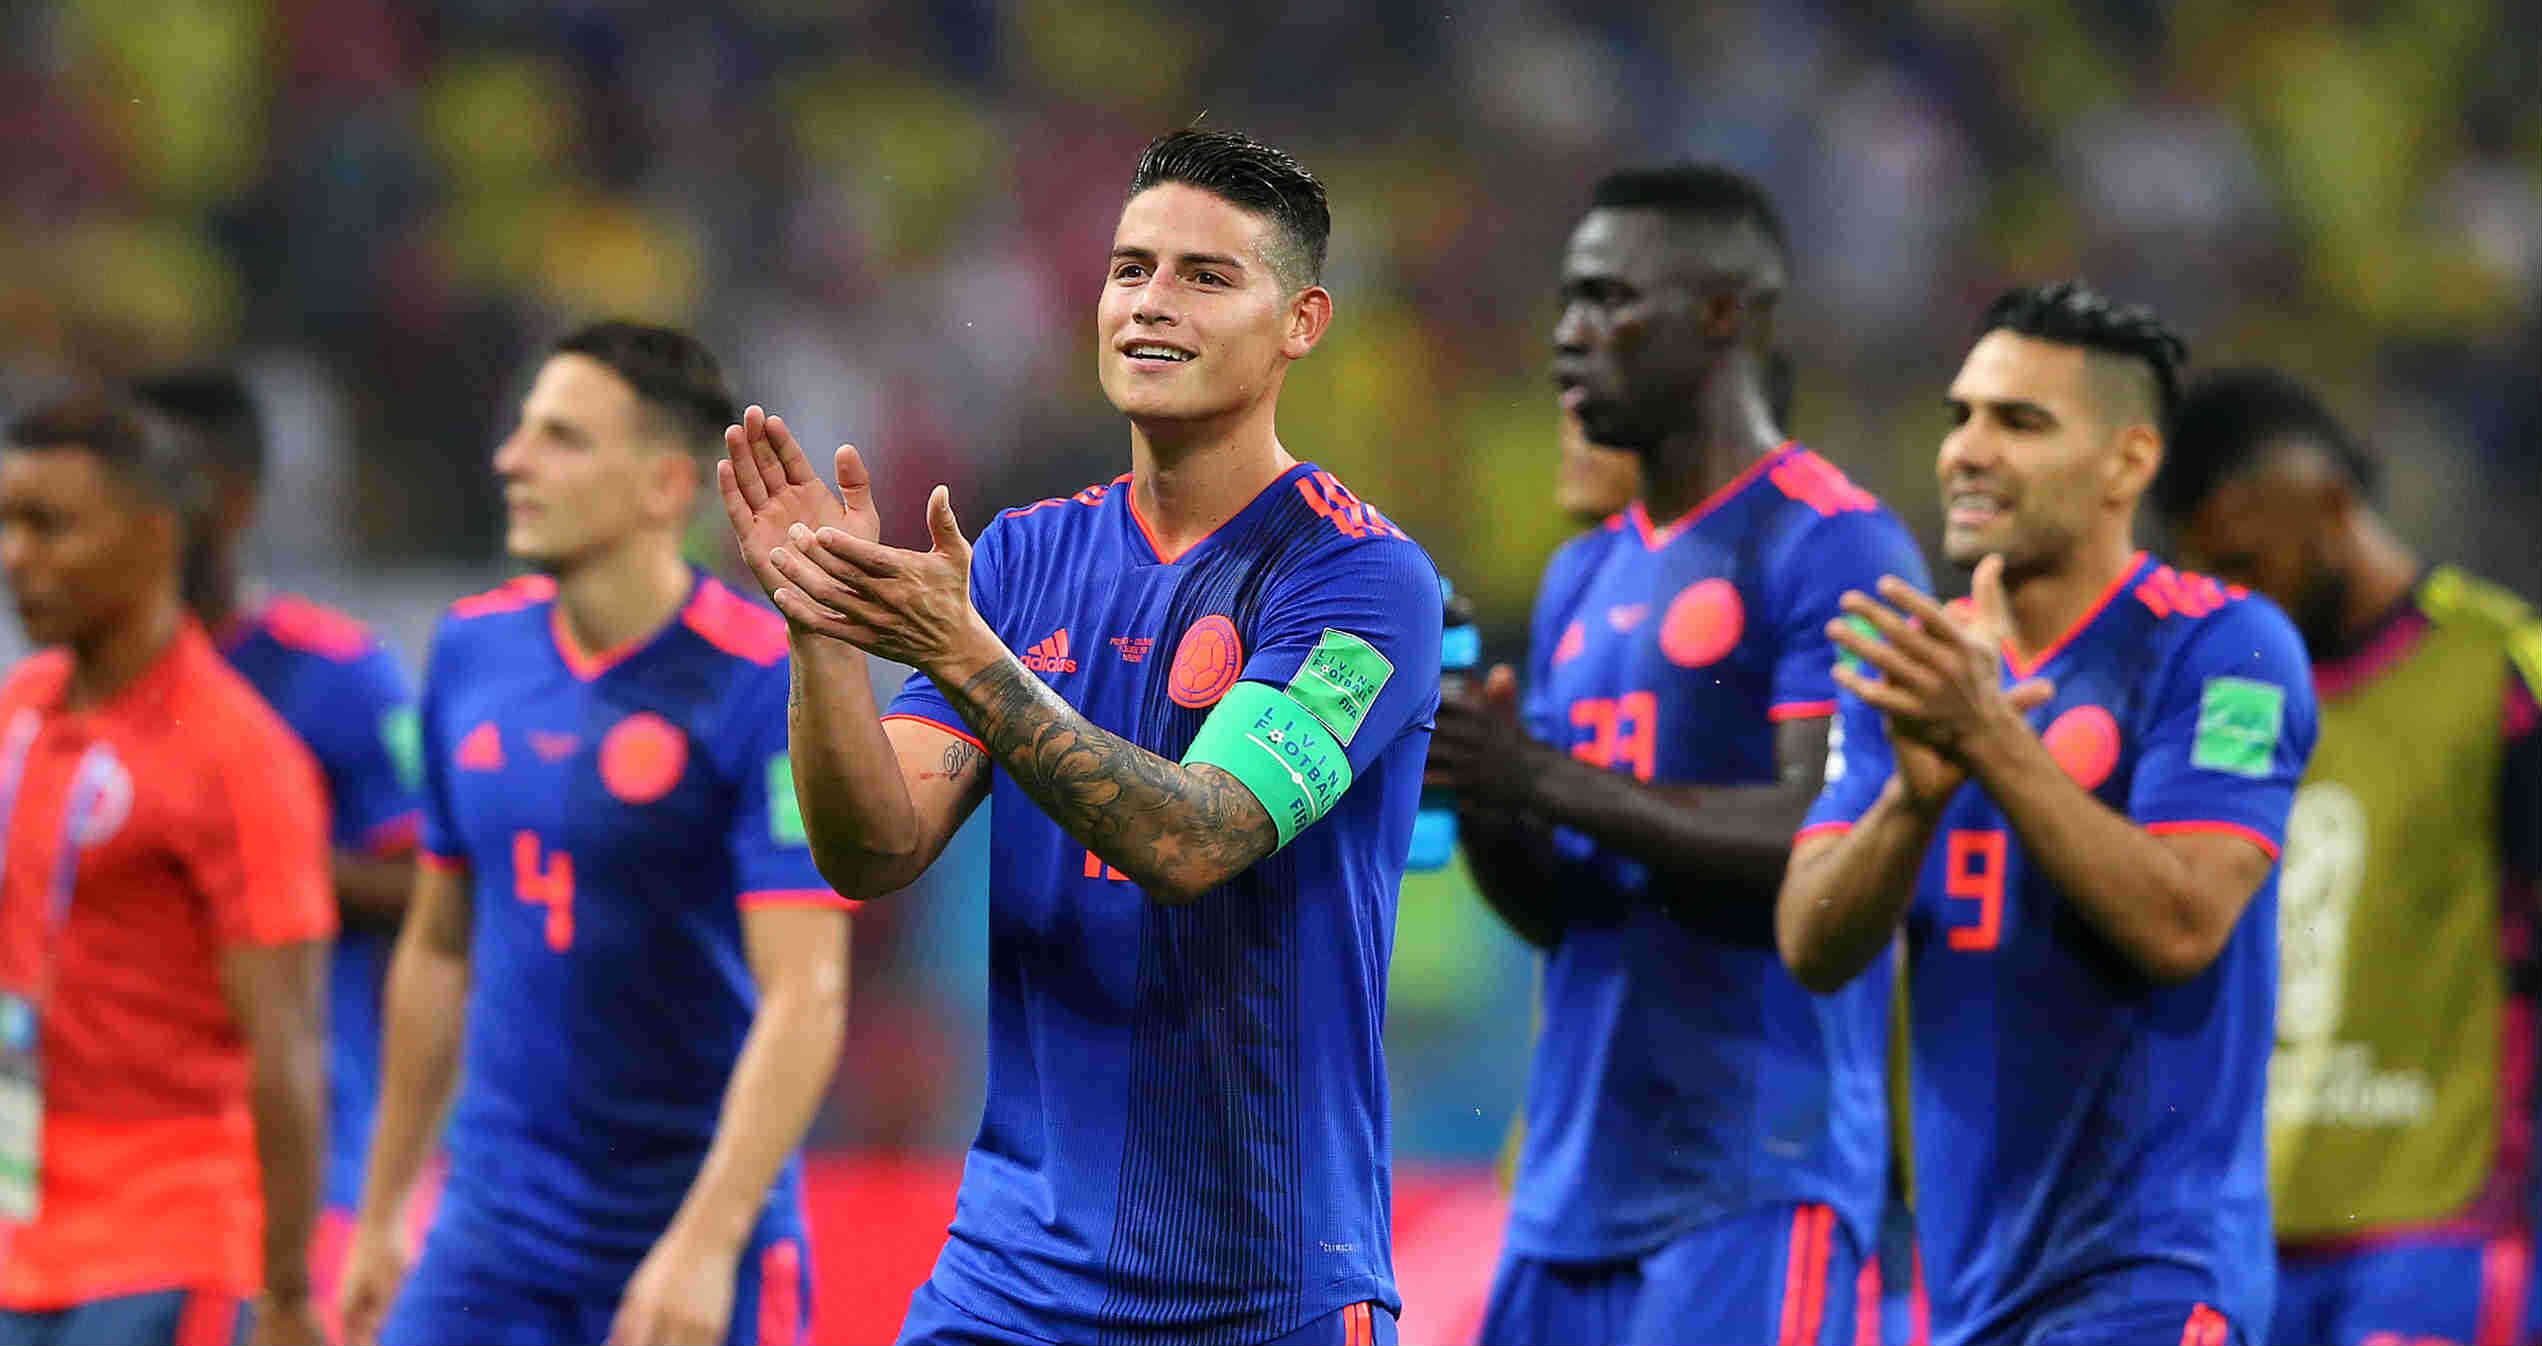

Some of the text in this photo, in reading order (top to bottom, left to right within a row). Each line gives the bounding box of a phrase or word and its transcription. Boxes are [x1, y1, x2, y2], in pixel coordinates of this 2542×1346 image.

[1020, 654, 1077, 674] adidas
[1319, 649, 1375, 694] LIVING
[1338, 697, 1358, 720] FIFA
[514, 830, 576, 953] 4
[1945, 829, 2008, 952] 9
